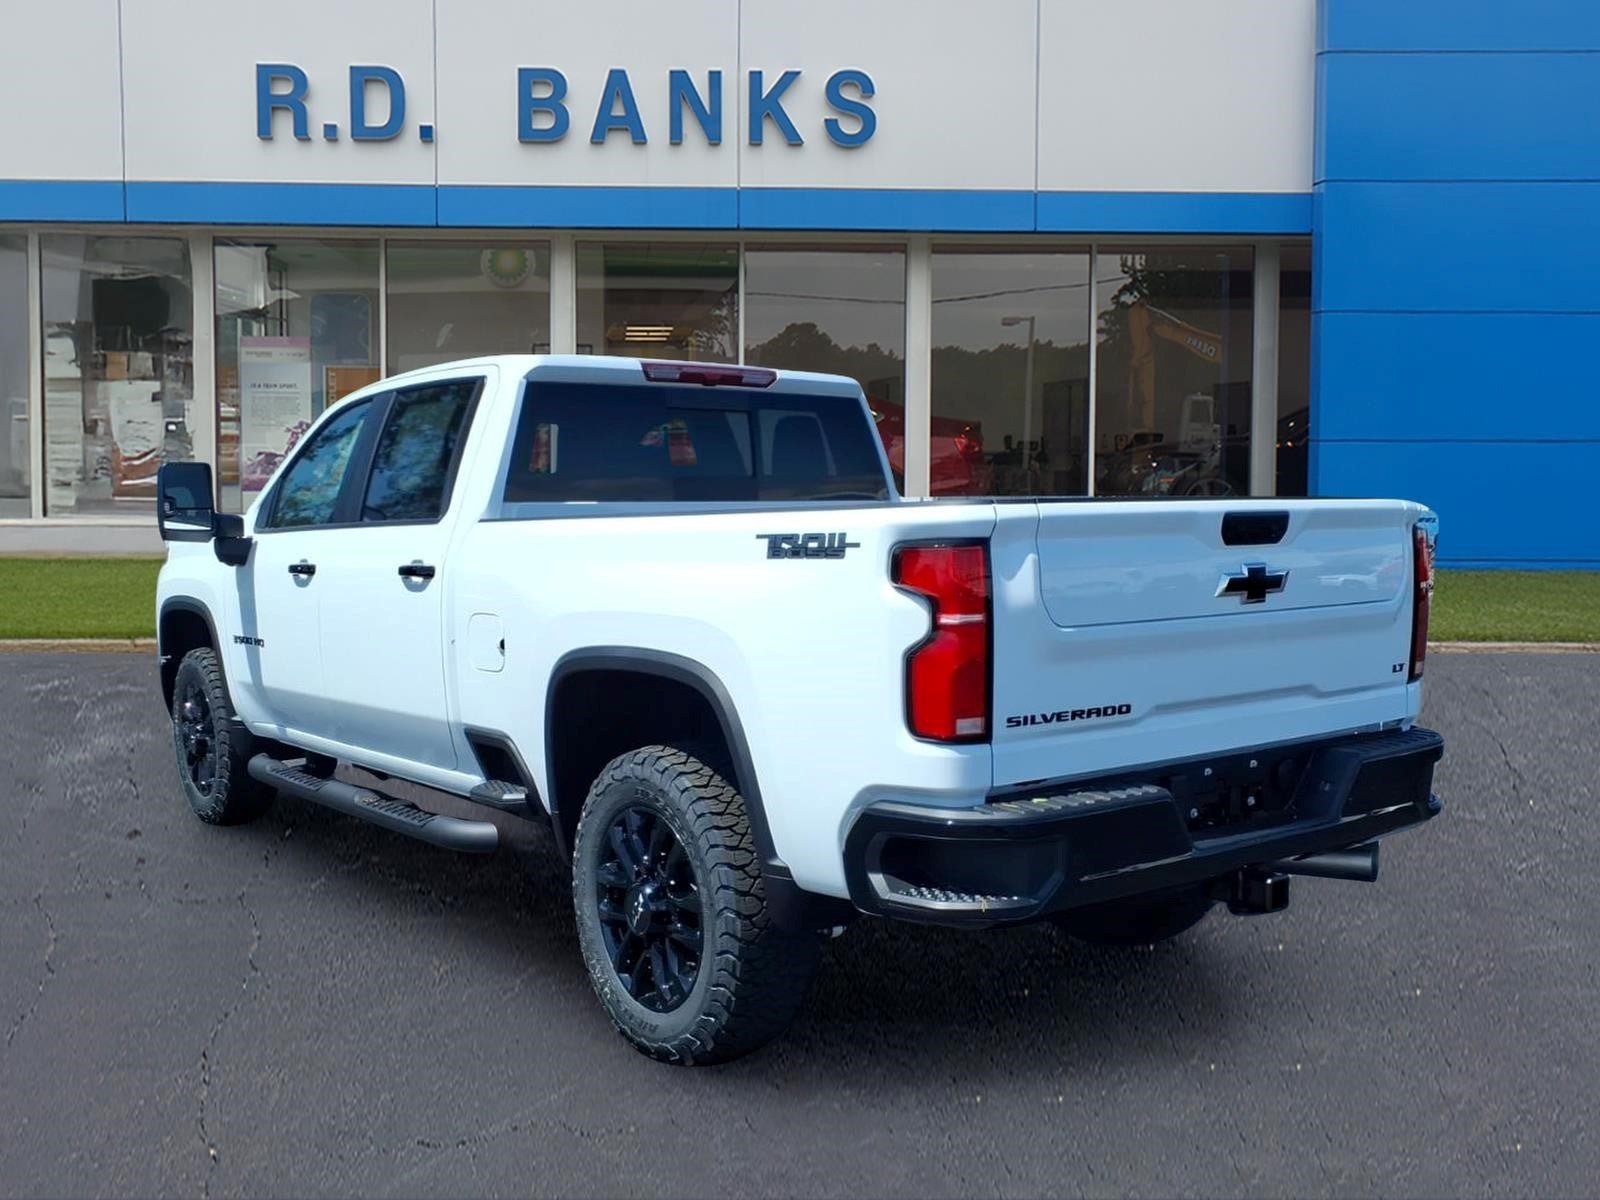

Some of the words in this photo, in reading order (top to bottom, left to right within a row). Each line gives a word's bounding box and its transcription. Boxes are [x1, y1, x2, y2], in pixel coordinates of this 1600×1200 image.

[256, 64, 434, 142] R.D.
[517, 69, 877, 148] BANKS
[1392, 663, 1405, 673] LT
[1006, 703, 1132, 728] SILVERADO
